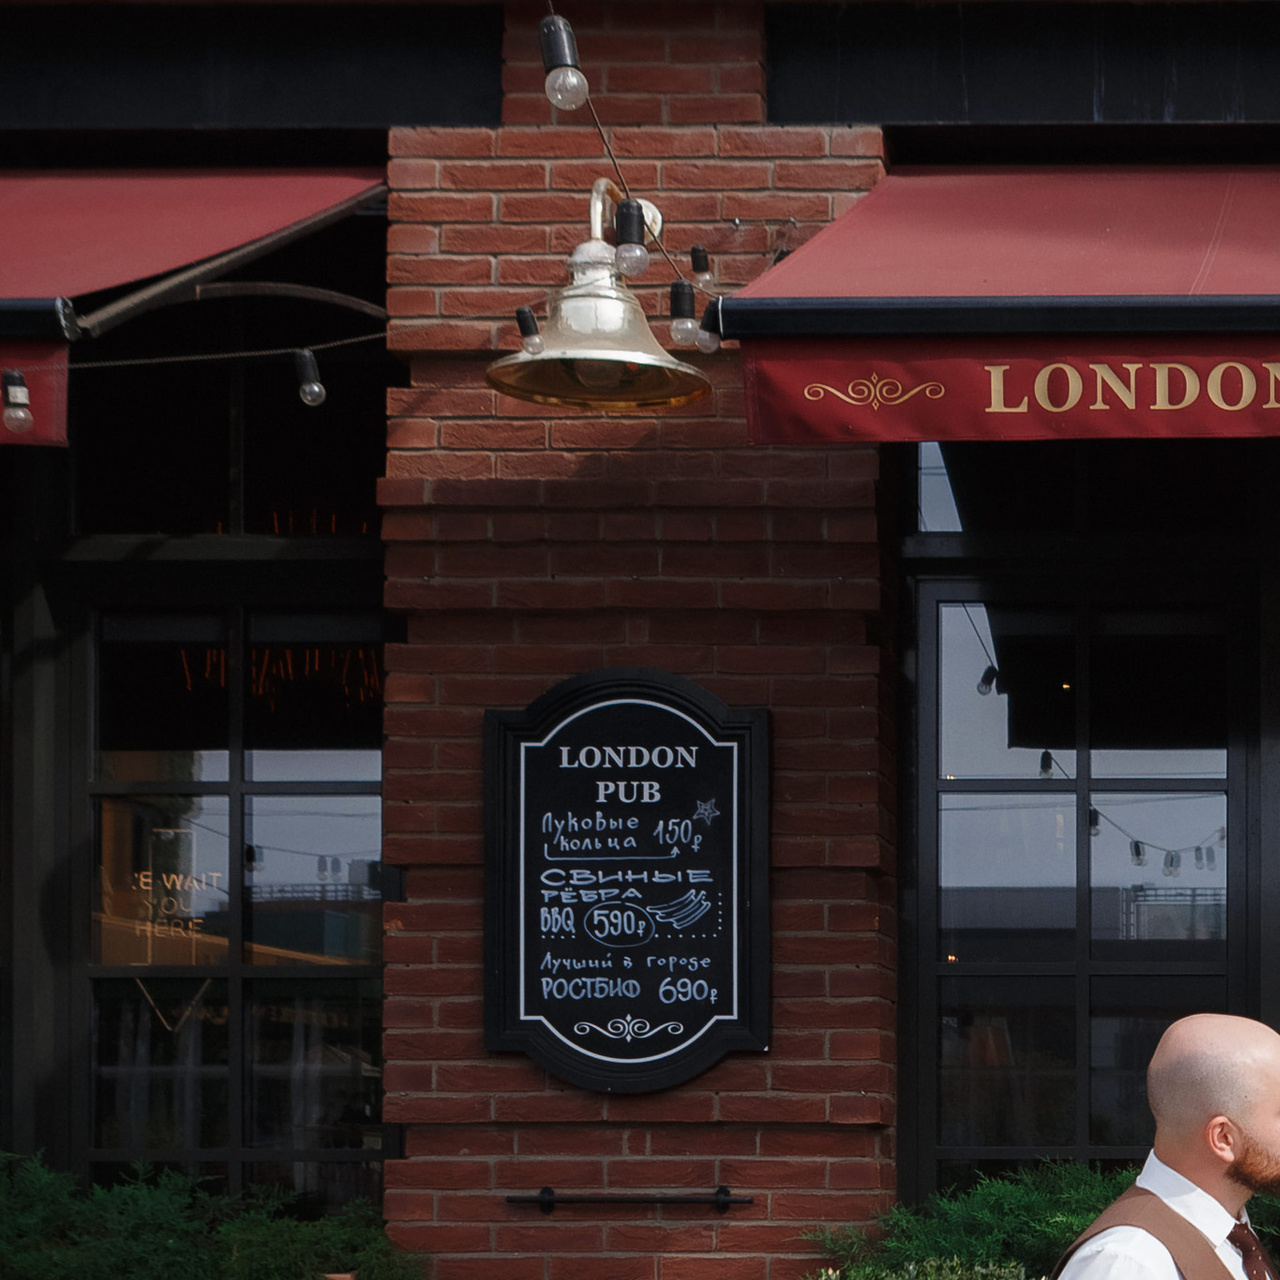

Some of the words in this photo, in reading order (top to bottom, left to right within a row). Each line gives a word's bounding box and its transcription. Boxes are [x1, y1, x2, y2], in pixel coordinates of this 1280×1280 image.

[559, 746, 698, 768] LONDON
[596, 780, 661, 803] PUB
[541, 811, 639, 844] Луковые
[560, 835, 637, 851] кольца
[162, 872, 222, 891] WAIT
[540, 868, 714, 886] СВИНЫЕ
[541, 887, 643, 903] РЁБРА
[135, 919, 204, 938] HERE
[540, 907, 576, 933] BBQ
[540, 951, 613, 974] Лучший
[541, 977, 641, 1000] РОСТБИФ
